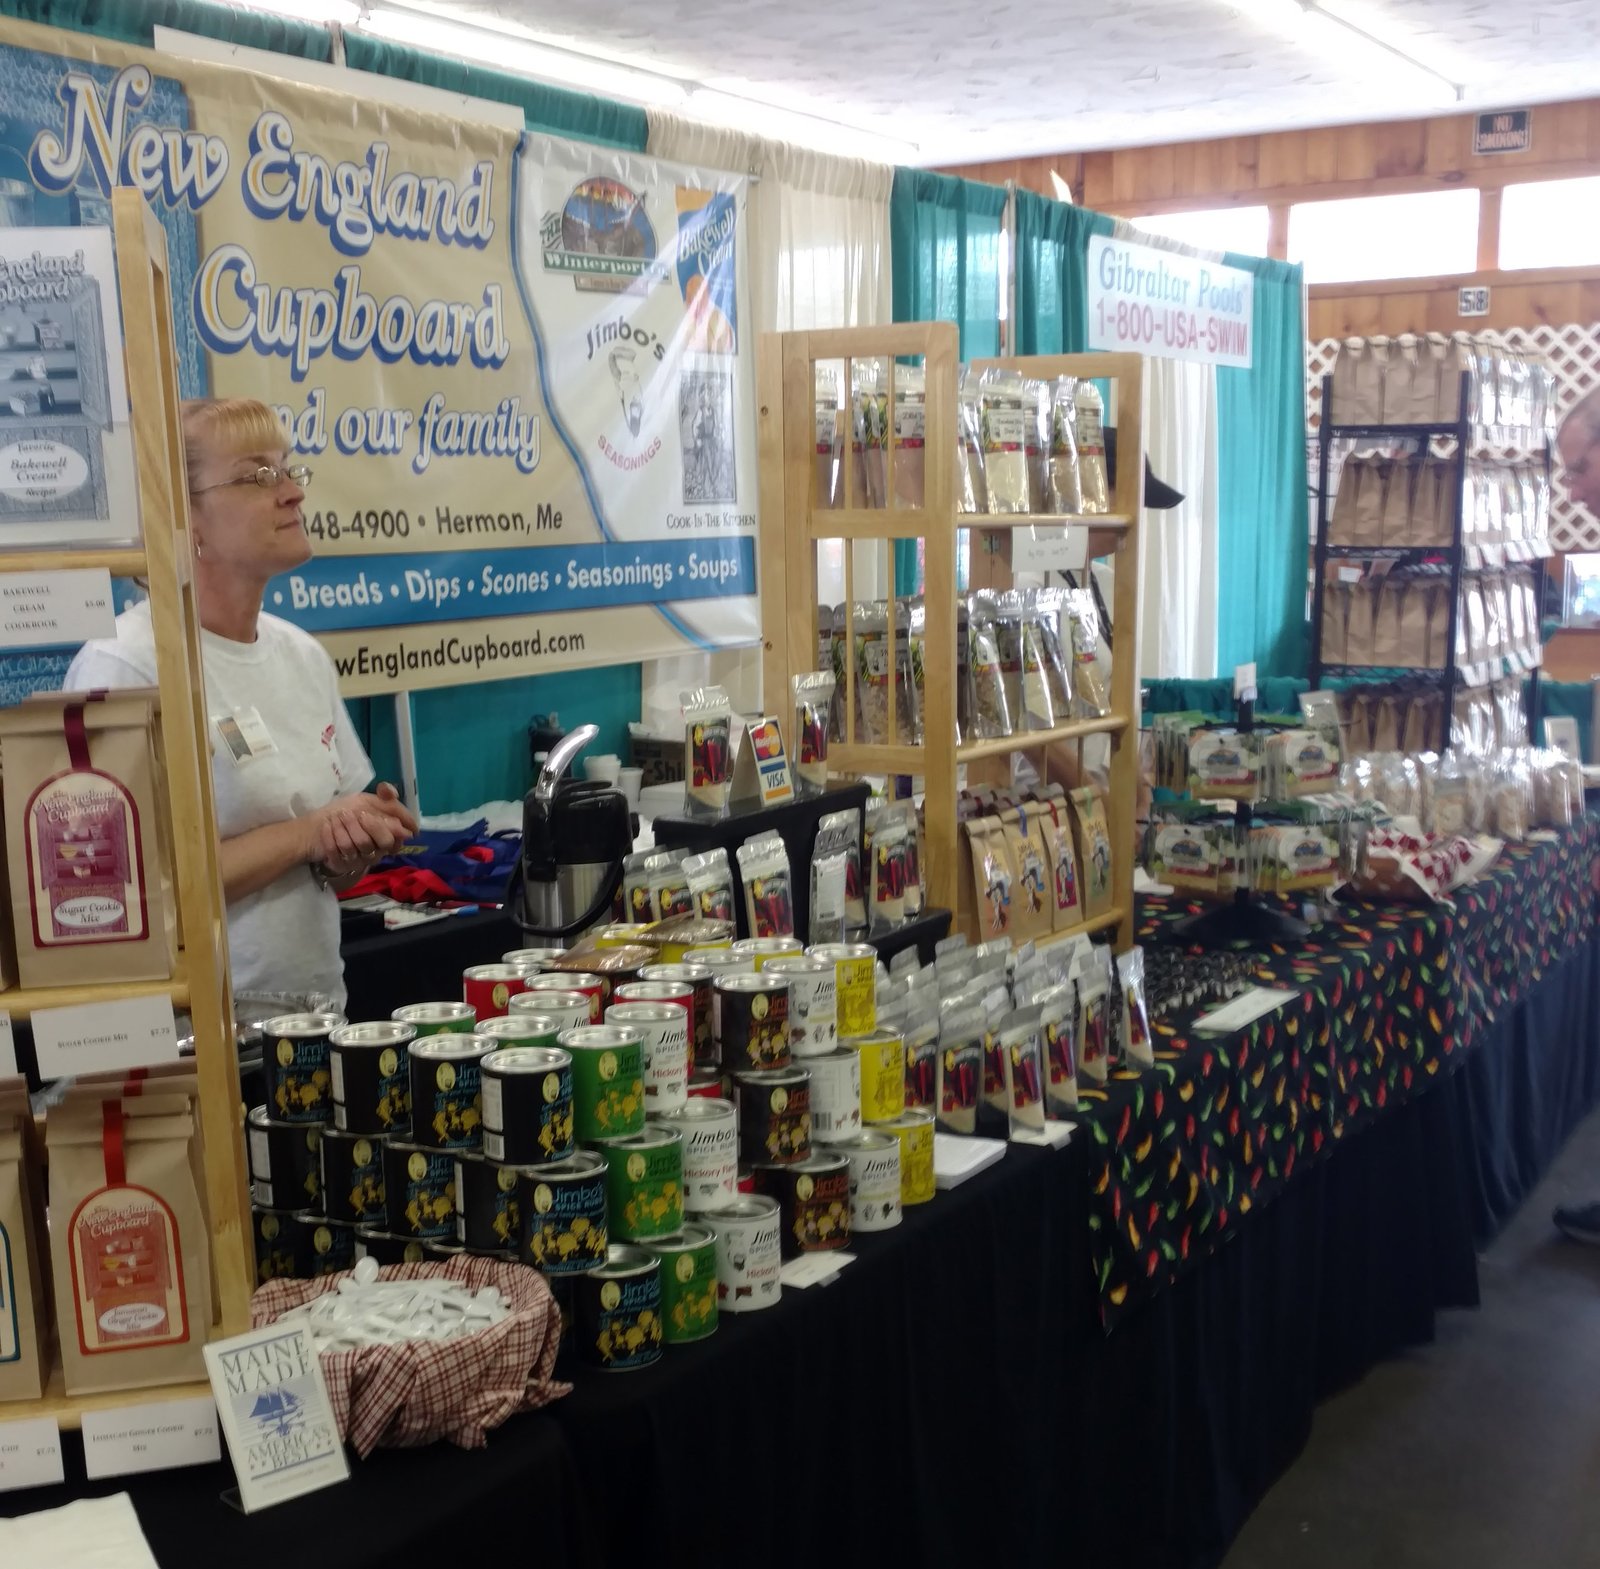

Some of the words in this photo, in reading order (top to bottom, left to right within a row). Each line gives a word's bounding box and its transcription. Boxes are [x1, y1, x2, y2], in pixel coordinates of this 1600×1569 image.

[27, 64, 230, 210] New
[242, 110, 495, 256] England
[680, 208, 734, 262] Bakewell
[545, 252, 645, 276] Winterport
[1100, 247, 1190, 304] Gibraltar
[1198, 269, 1243, 315] Pools
[193, 243, 510, 382] Cupboard
[1460, 290, 1488, 312] 58
[586, 315, 666, 361] Jimbo's
[1097, 297, 1248, 356] 1-800-USA-SWIM
[269, 386, 328, 455] nd
[333, 405, 413, 458] our
[412, 392, 541, 475] family
[17, 442, 56, 453] Favorite
[598, 435, 663, 471] SEASONINGS
[10, 457, 67, 470] Bakewell
[435, 506, 530, 538] Hermon,
[537, 504, 563, 530] Me
[3, 586, 51, 596] BAKEWELL
[290, 572, 383, 609] Breads
[404, 568, 461, 608] Dips
[480, 565, 550, 597] Scones
[566, 556, 673, 590] Seasonings
[688, 552, 738, 582] Soups
[13, 603, 45, 613] CREAM
[4, 620, 57, 631] COOKBOOK
[335, 629, 585, 679] wEnglandCupboard.com
[767, 771, 785, 788] VISA
[47, 800, 109, 824] Cupboard
[58, 903, 87, 918] Sugar
[89, 900, 120, 914] Cookie
[80, 913, 101, 924] Mix
[91, 1215, 150, 1240] Cupboard
[221, 1336, 309, 1377] MAINE
[226, 1356, 314, 1397] MADE
[271, 1448, 310, 1470] BEST
